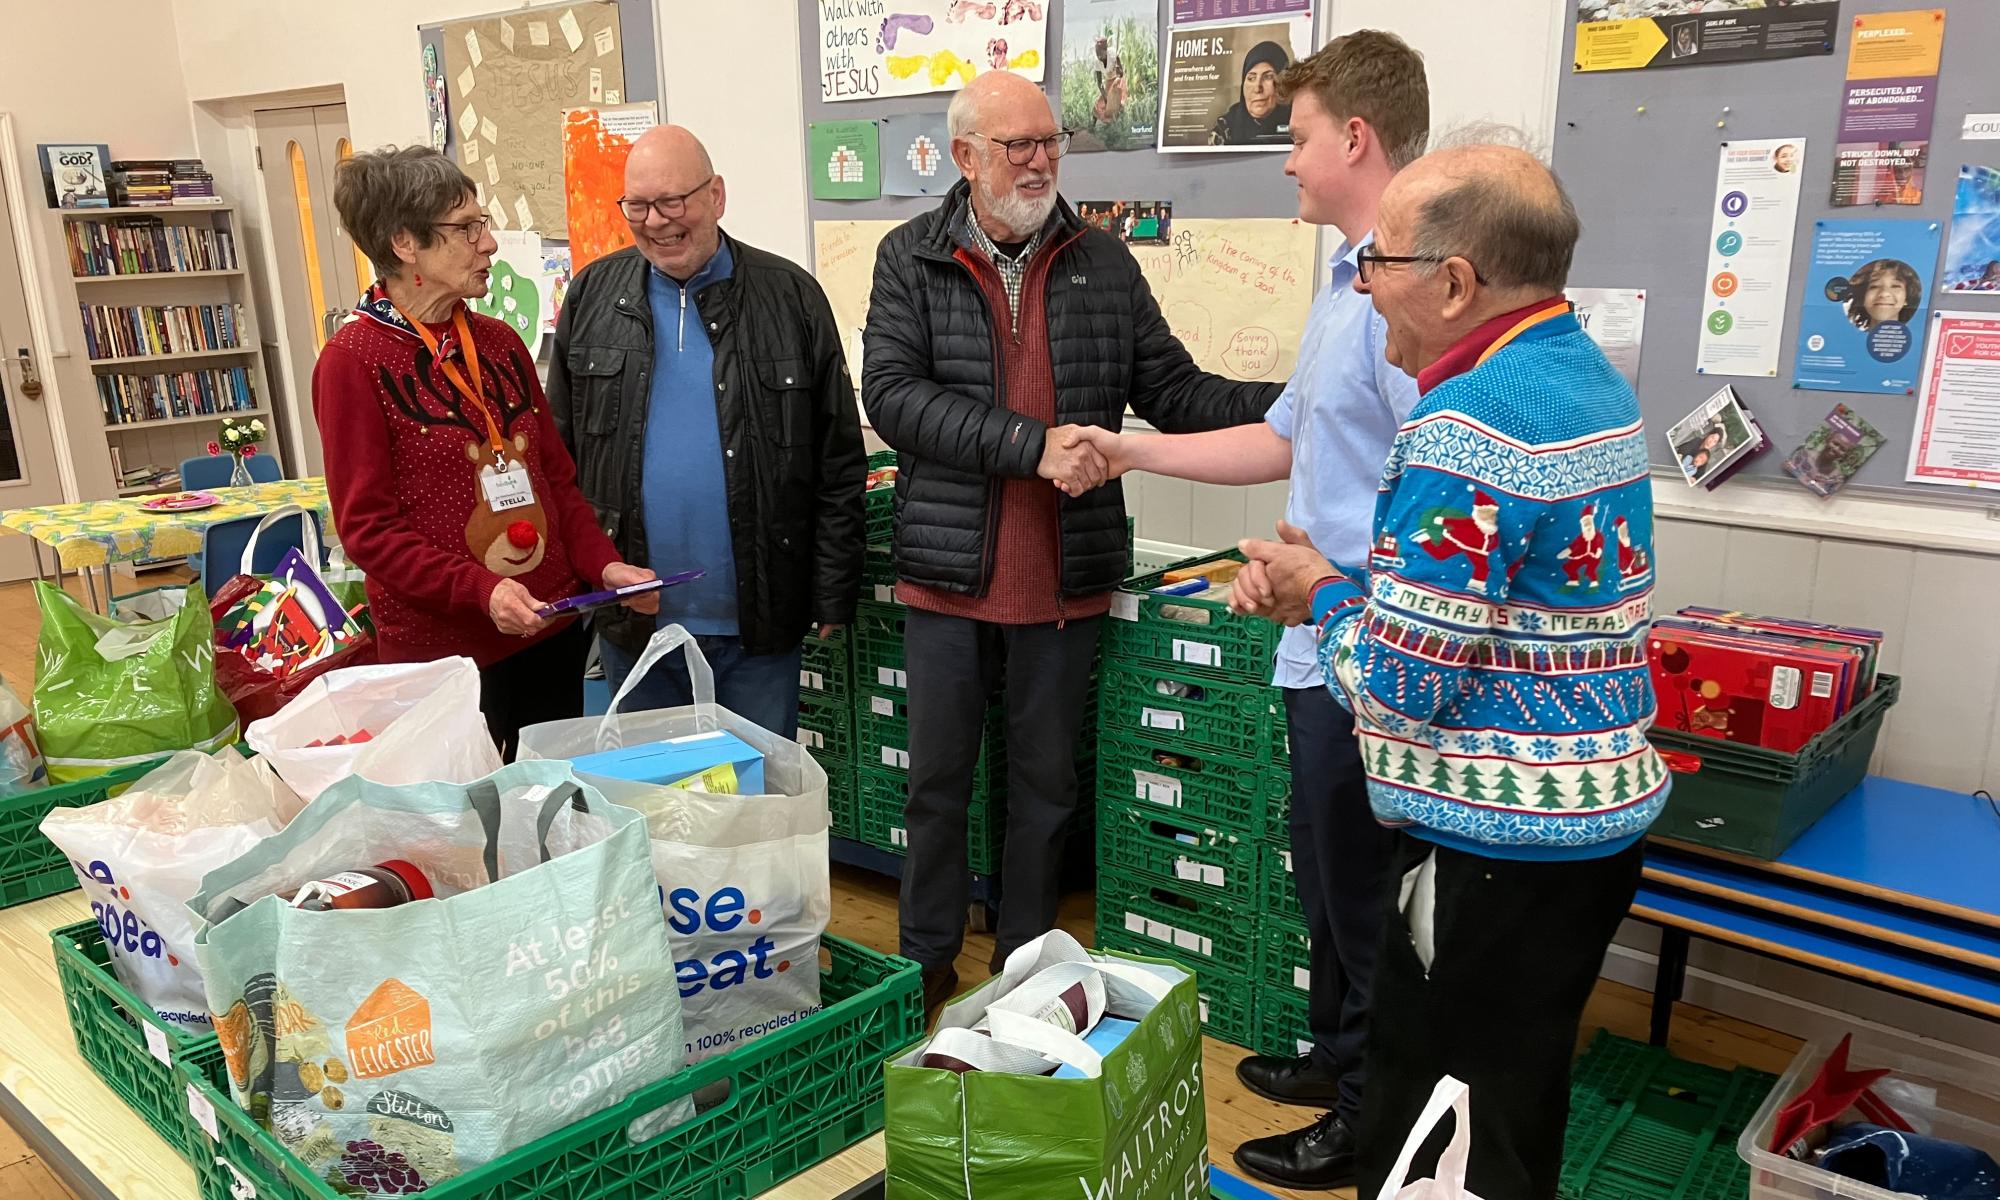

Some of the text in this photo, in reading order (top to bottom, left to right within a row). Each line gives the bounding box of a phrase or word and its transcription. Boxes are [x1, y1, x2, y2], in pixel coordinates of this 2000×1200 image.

[823, 1, 854, 22] Walk
[826, 27, 868, 48] others
[1857, 28, 1913, 39] PERPLEXED...
[1175, 37, 1233, 58] HOME IS...
[827, 48, 855, 70] with
[825, 65, 879, 97] JESUS
[1850, 85, 1923, 97] PERSECUTED, BUT
[1848, 97, 1865, 105] NOT
[59, 151, 94, 166] GOD?
[1840, 157, 1913, 167] NOT DESTROYED...
[1841, 148, 1920, 159] STRUCK DOWN, BUT
[1141, 253, 1172, 283] ring
[1220, 238, 1237, 257] The
[1282, 268, 1297, 286] the
[1175, 327, 1200, 342] ood
[1236, 332, 1269, 350] Saying
[1235, 345, 1267, 357] thank
[1241, 360, 1261, 372] you
[499, 495, 527, 507] STELLA
[1398, 590, 1483, 624] MERRY
[1550, 614, 1624, 631] MERRY
[658, 885, 762, 935] se.
[506, 895, 631, 977] At least
[544, 940, 619, 999] 50%
[674, 935, 791, 998] eat.
[156, 1009, 208, 1025] recycled
[534, 972, 642, 1041] of this
[368, 1017, 406, 1041] Red
[564, 1013, 627, 1063] bag
[696, 1028, 736, 1052] 100%
[738, 1009, 798, 1040] recycled
[349, 1029, 435, 1077] LEICESTER
[550, 1034, 657, 1110] comes
[376, 1090, 450, 1130] Stilton
[1079, 1060, 1200, 1200] WAITROS
